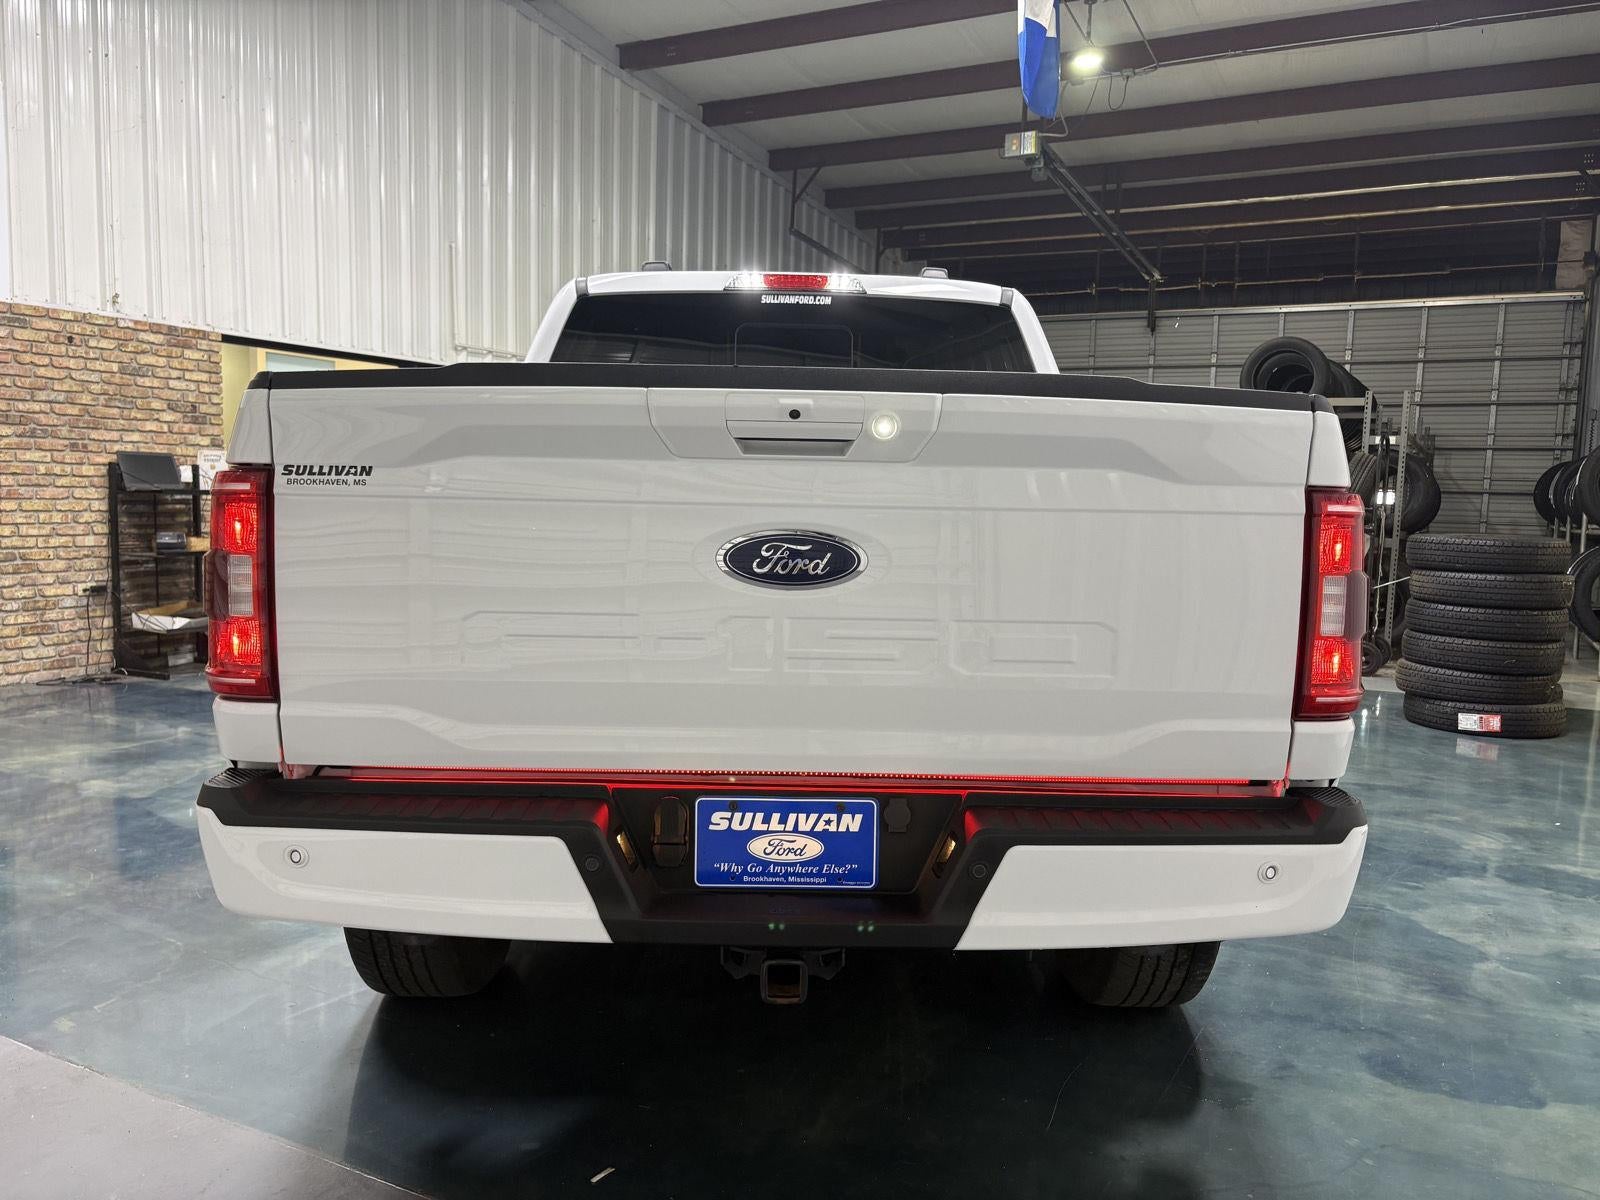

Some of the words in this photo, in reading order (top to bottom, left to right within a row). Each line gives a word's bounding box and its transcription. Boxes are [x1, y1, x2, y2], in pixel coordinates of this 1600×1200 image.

[761, 294, 832, 305] SULLIVANFORD.COM
[281, 464, 373, 477] SULLIVAN
[286, 478, 351, 487] BROOKHAVEN,
[752, 542, 832, 576] Ford
[708, 811, 863, 832] SULLIVAN
[763, 837, 807, 857] Ford
[747, 863, 762, 873] Go
[766, 863, 819, 875] Anywhere
[743, 875, 786, 883] Brookhaven,
